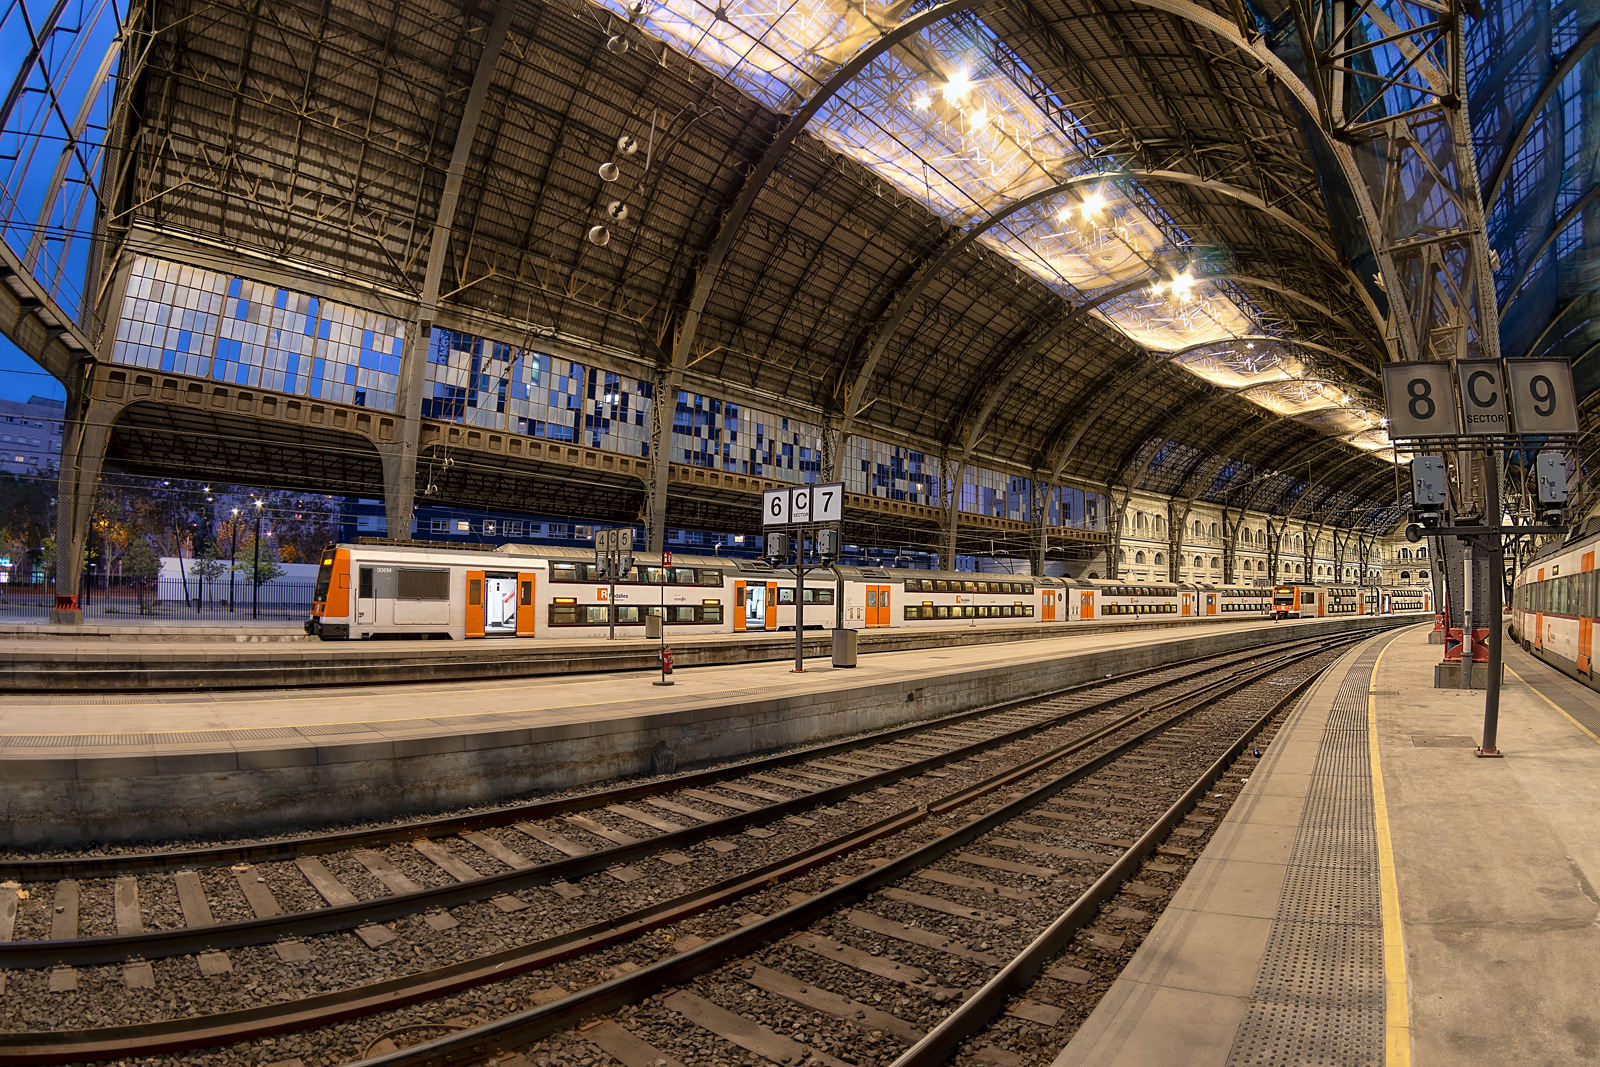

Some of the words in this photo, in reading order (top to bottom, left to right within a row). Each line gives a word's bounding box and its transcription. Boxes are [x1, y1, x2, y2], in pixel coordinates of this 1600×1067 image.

[1467, 370, 1498, 408] C
[1529, 375, 1557, 417] 9
[1407, 378, 1436, 420] 8
[1467, 414, 1505, 424] SECTOR
[770, 496, 782, 517] 6
[795, 492, 807, 510] C
[822, 491, 834, 513] 7
[599, 534, 604, 546] 4
[610, 532, 616, 544] C
[622, 532, 628, 546] 5
